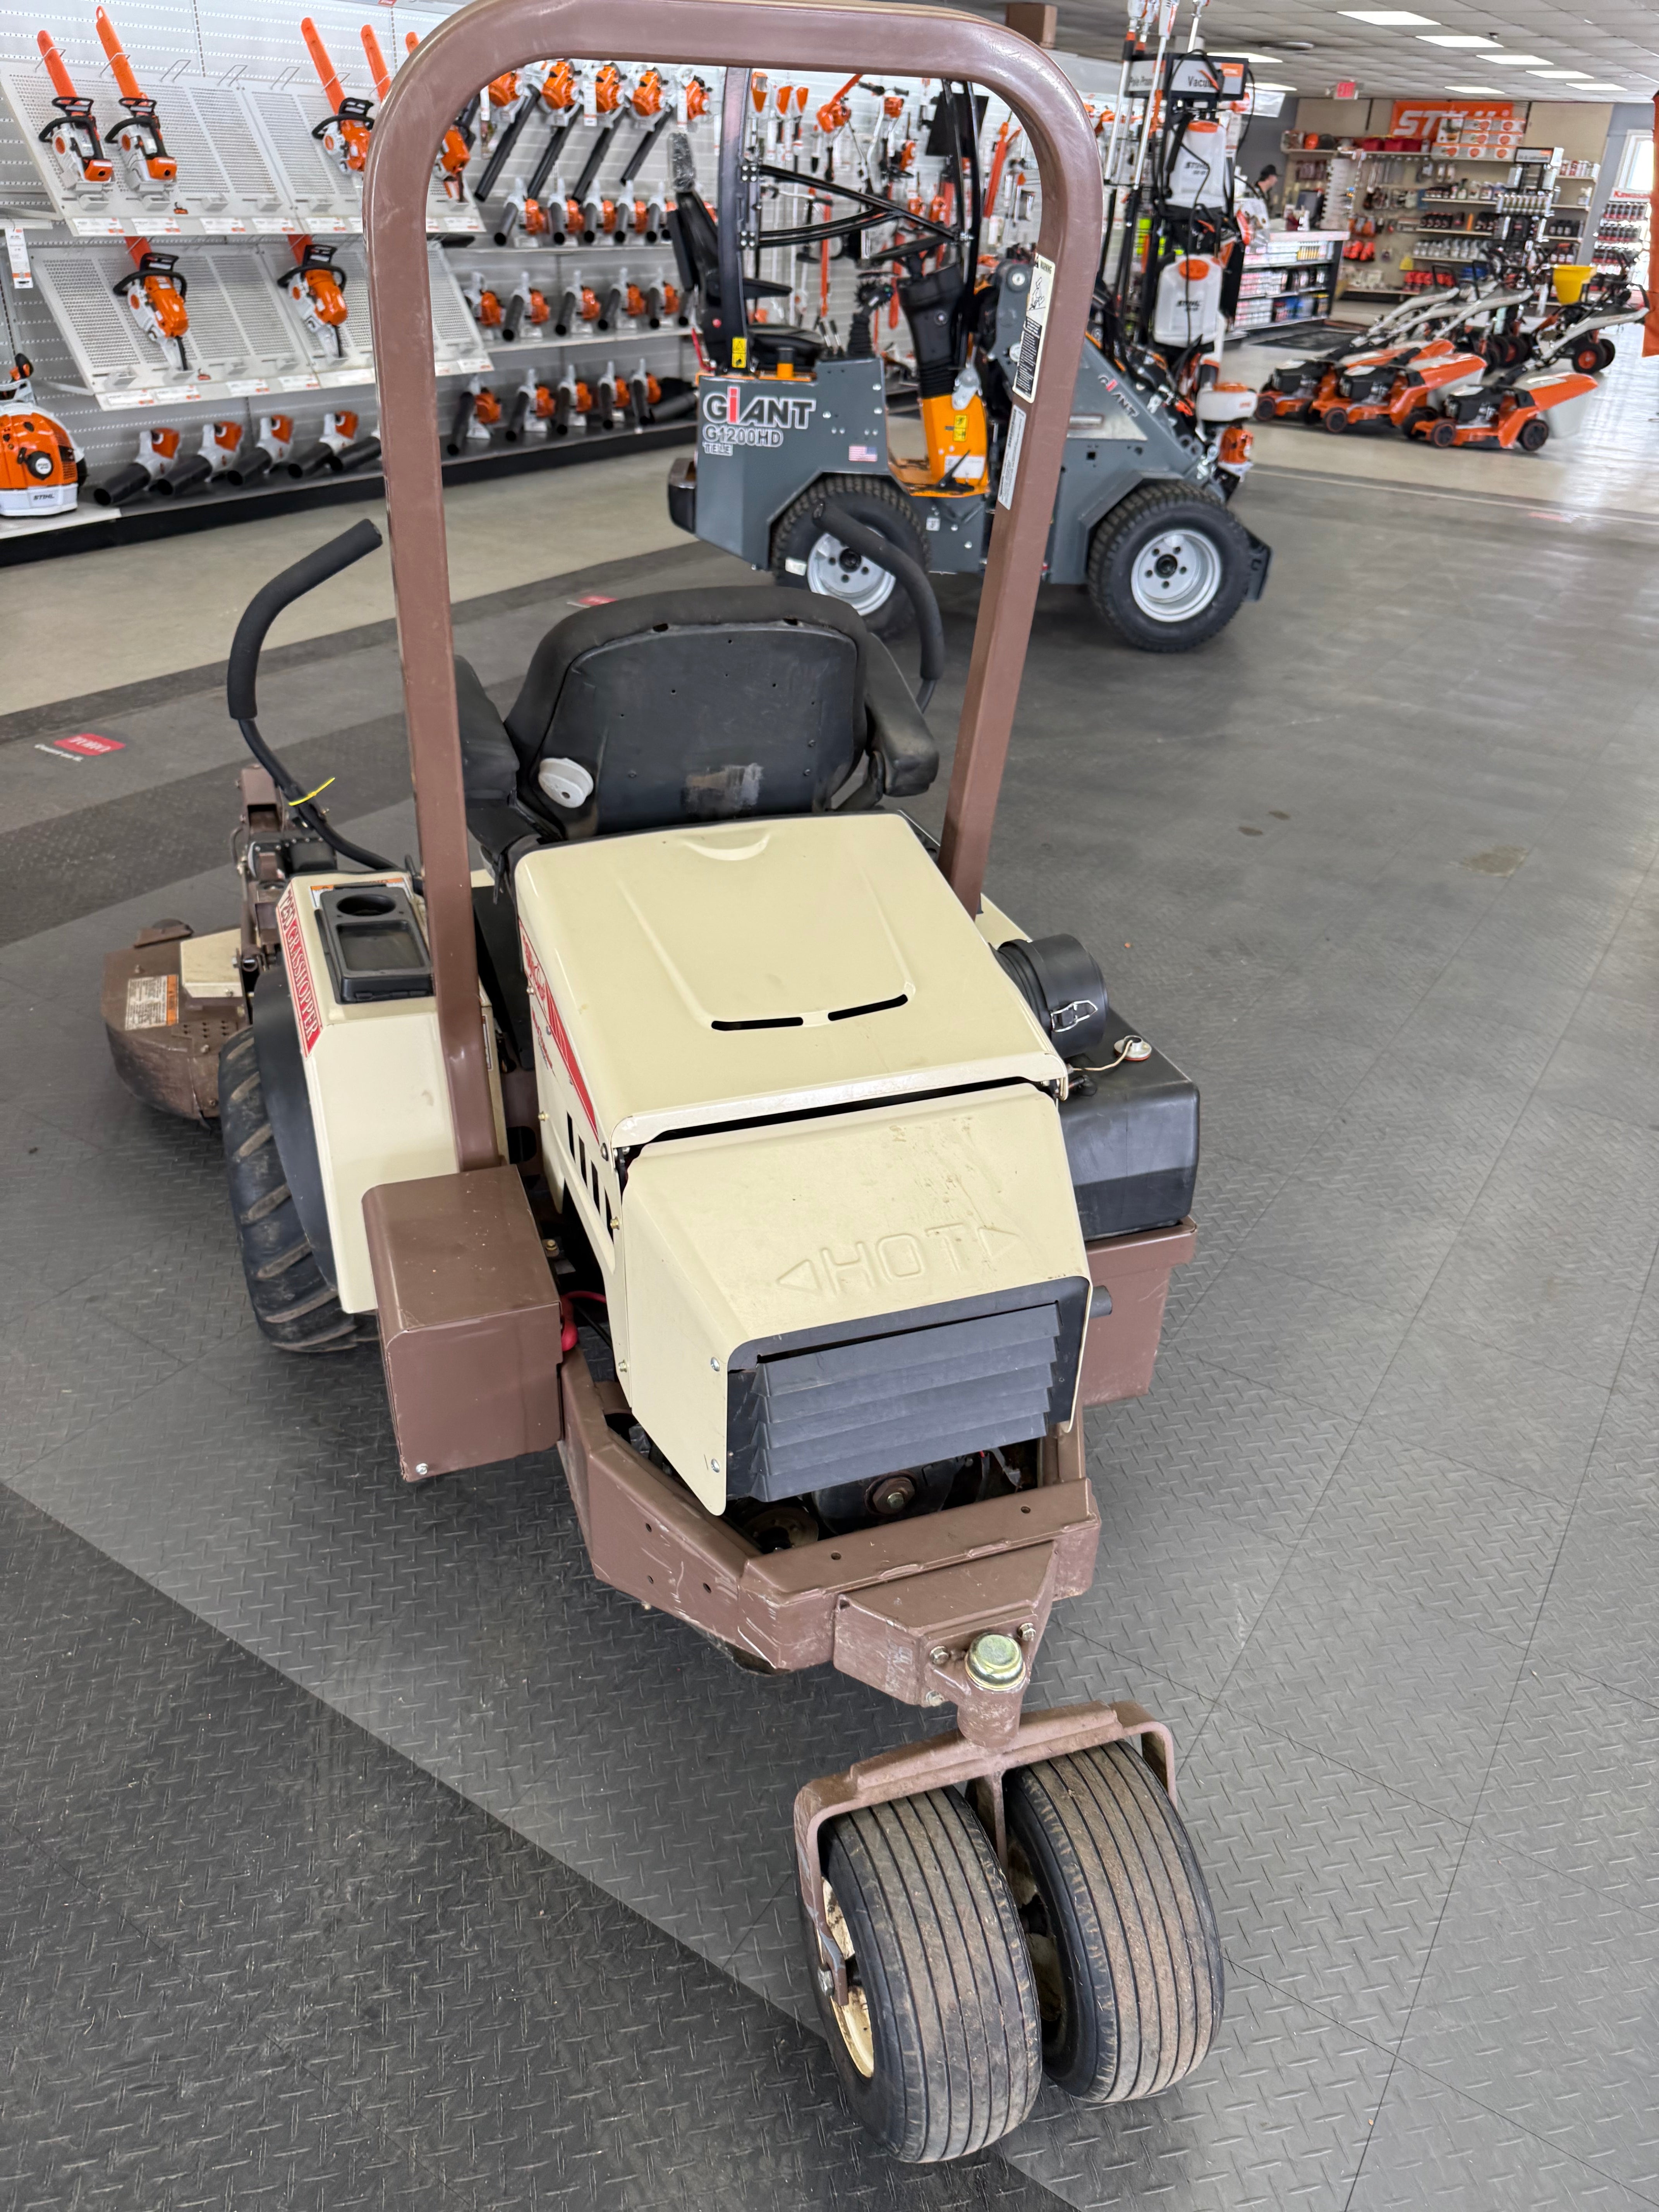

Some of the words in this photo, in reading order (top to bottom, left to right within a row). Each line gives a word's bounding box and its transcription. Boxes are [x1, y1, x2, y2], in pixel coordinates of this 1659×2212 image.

[1188, 75, 1213, 87] Vacu
[702, 442, 732, 455] TELE
[703, 424, 783, 447] G1200HD
[279, 890, 296, 931] 725D
[285, 924, 319, 1042] GRASSHOPPER
[819, 1221, 965, 1295] HOT
